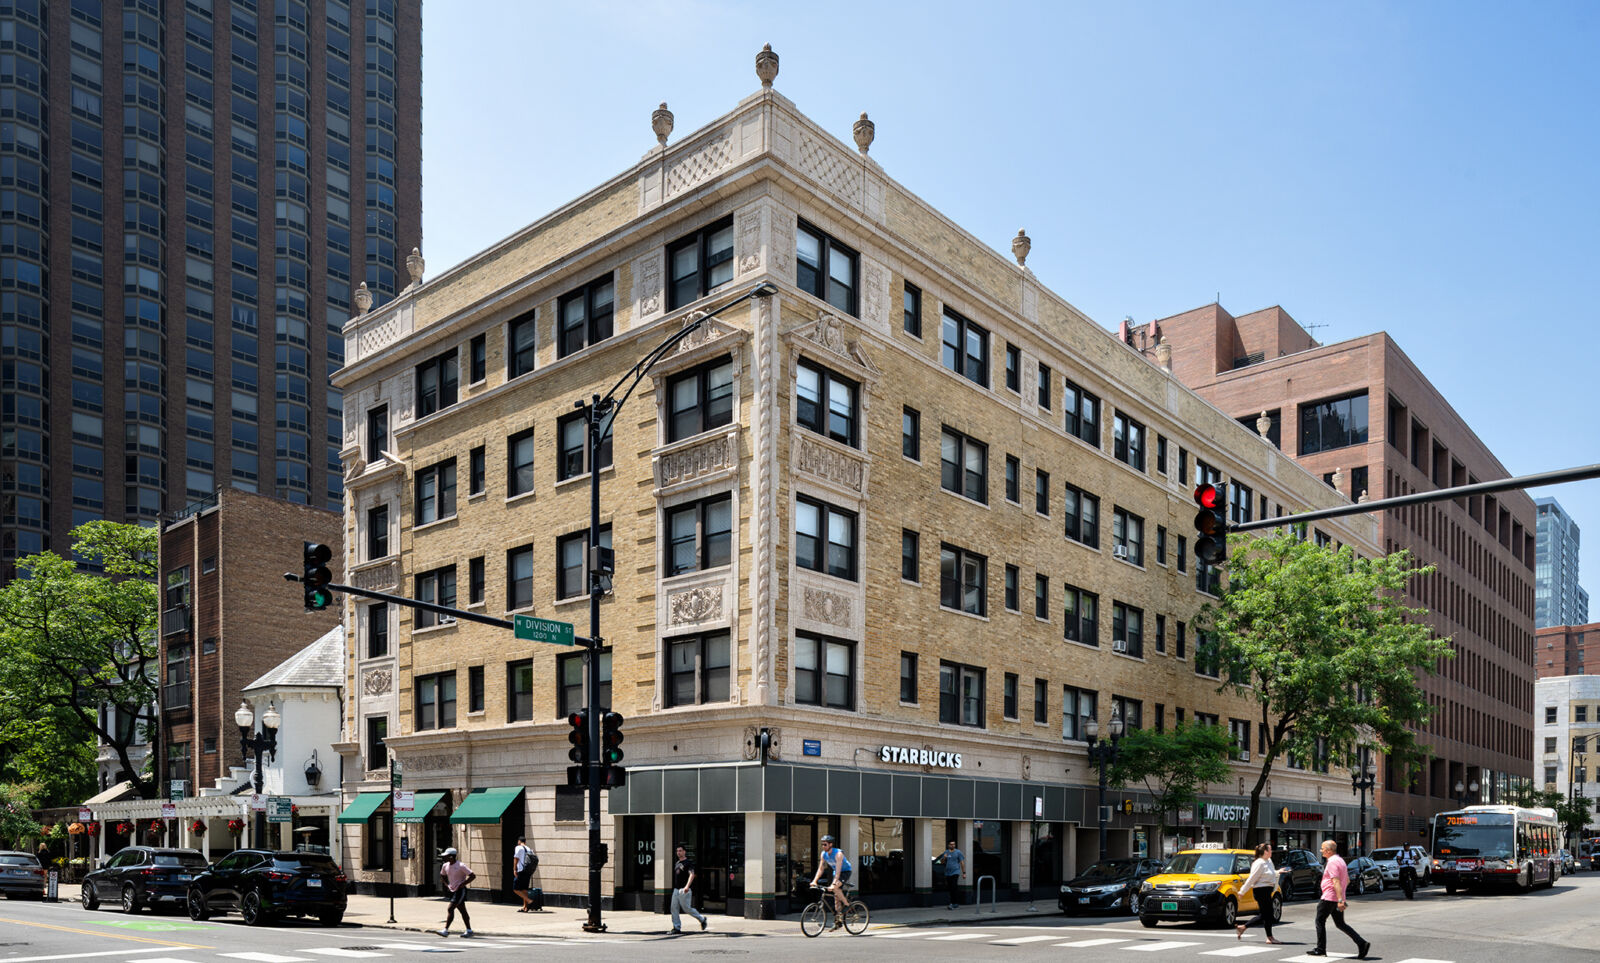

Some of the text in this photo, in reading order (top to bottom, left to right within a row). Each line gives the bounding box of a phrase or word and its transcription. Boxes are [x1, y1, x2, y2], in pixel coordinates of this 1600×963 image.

[526, 619, 560, 633] DIVISION
[533, 632, 547, 640] 1200
[881, 746, 962, 769] STARBUCKS
[1447, 817, 1456, 825] 70
[638, 841, 656, 851] PIC
[863, 841, 886, 852] PICK
[638, 854, 652, 865] UP
[863, 855, 875, 866] UP
